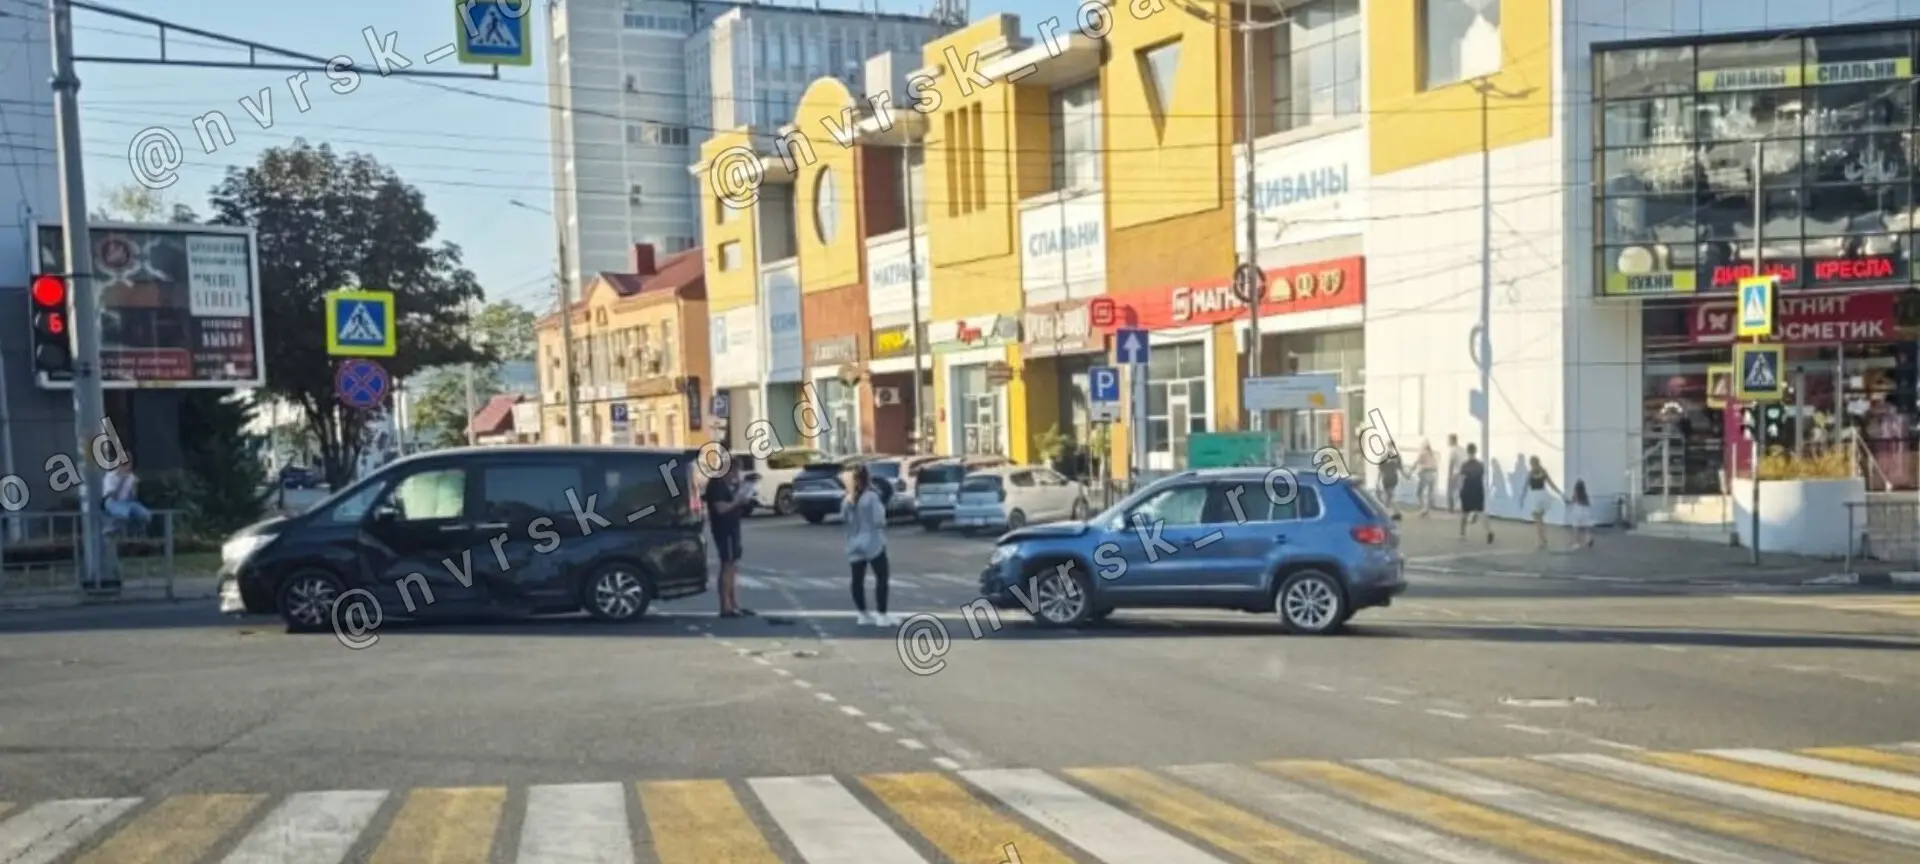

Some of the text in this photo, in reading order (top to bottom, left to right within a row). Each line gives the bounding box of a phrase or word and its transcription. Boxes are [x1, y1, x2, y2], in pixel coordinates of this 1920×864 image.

[1816, 59, 1895, 81] СПАЛЬНИ
[1253, 163, 1348, 213] ДИВАНЫ
[874, 257, 925, 288] МАТРАЫ
[1711, 263, 1796, 286] ДИВНЫ
[1814, 259, 1893, 281] КРЕСЛА
[1779, 296, 1850, 315] АГНИТ
[48, 312, 63, 334] 6
[1764, 320, 1884, 341] ОСМЕТИК
[1097, 371, 1114, 398] P
[614, 406, 625, 418] P
